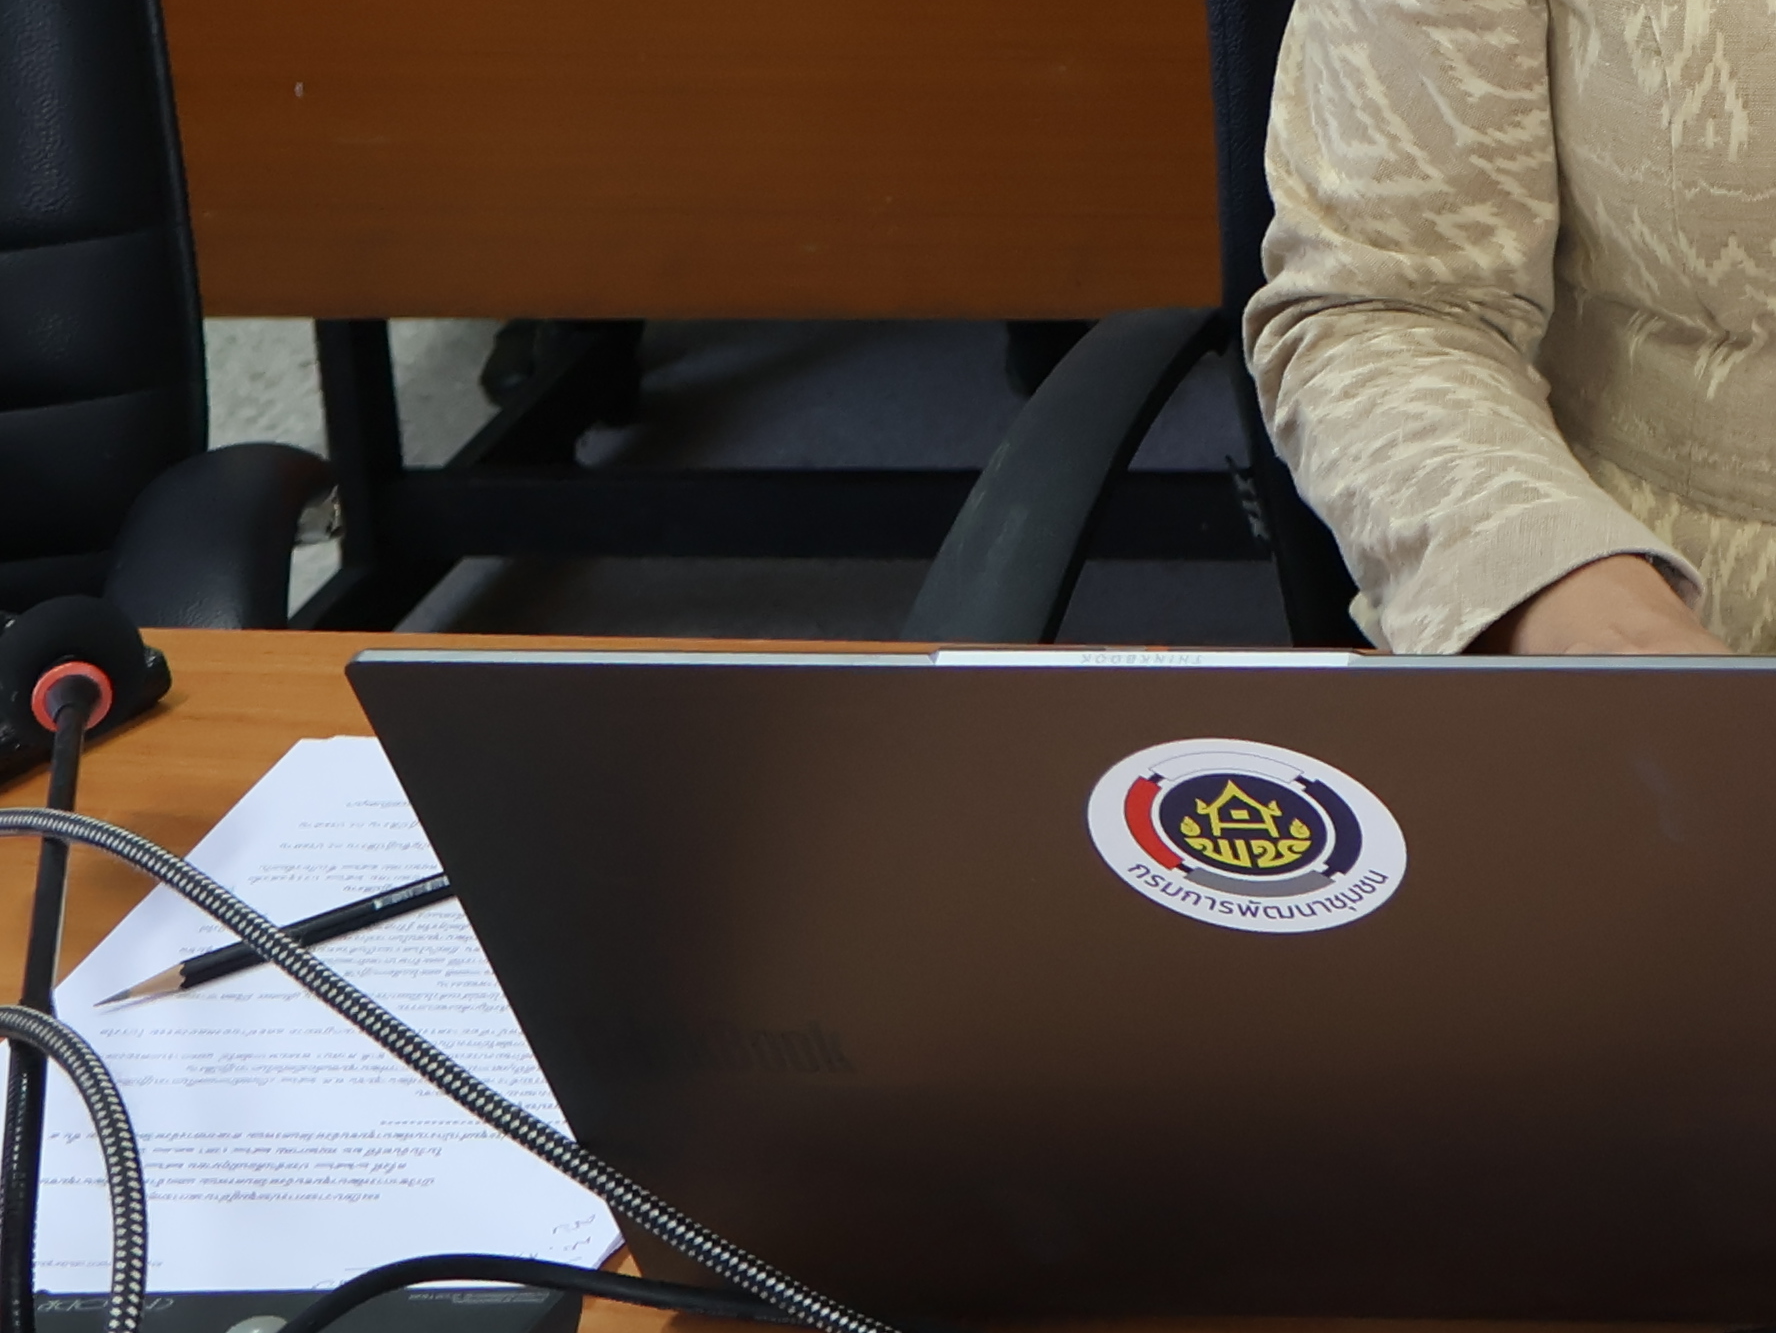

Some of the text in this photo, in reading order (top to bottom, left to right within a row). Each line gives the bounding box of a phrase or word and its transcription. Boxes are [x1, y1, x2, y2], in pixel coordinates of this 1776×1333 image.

[1127, 861, 1389, 920] กรมการพัฒนาชุมชน
